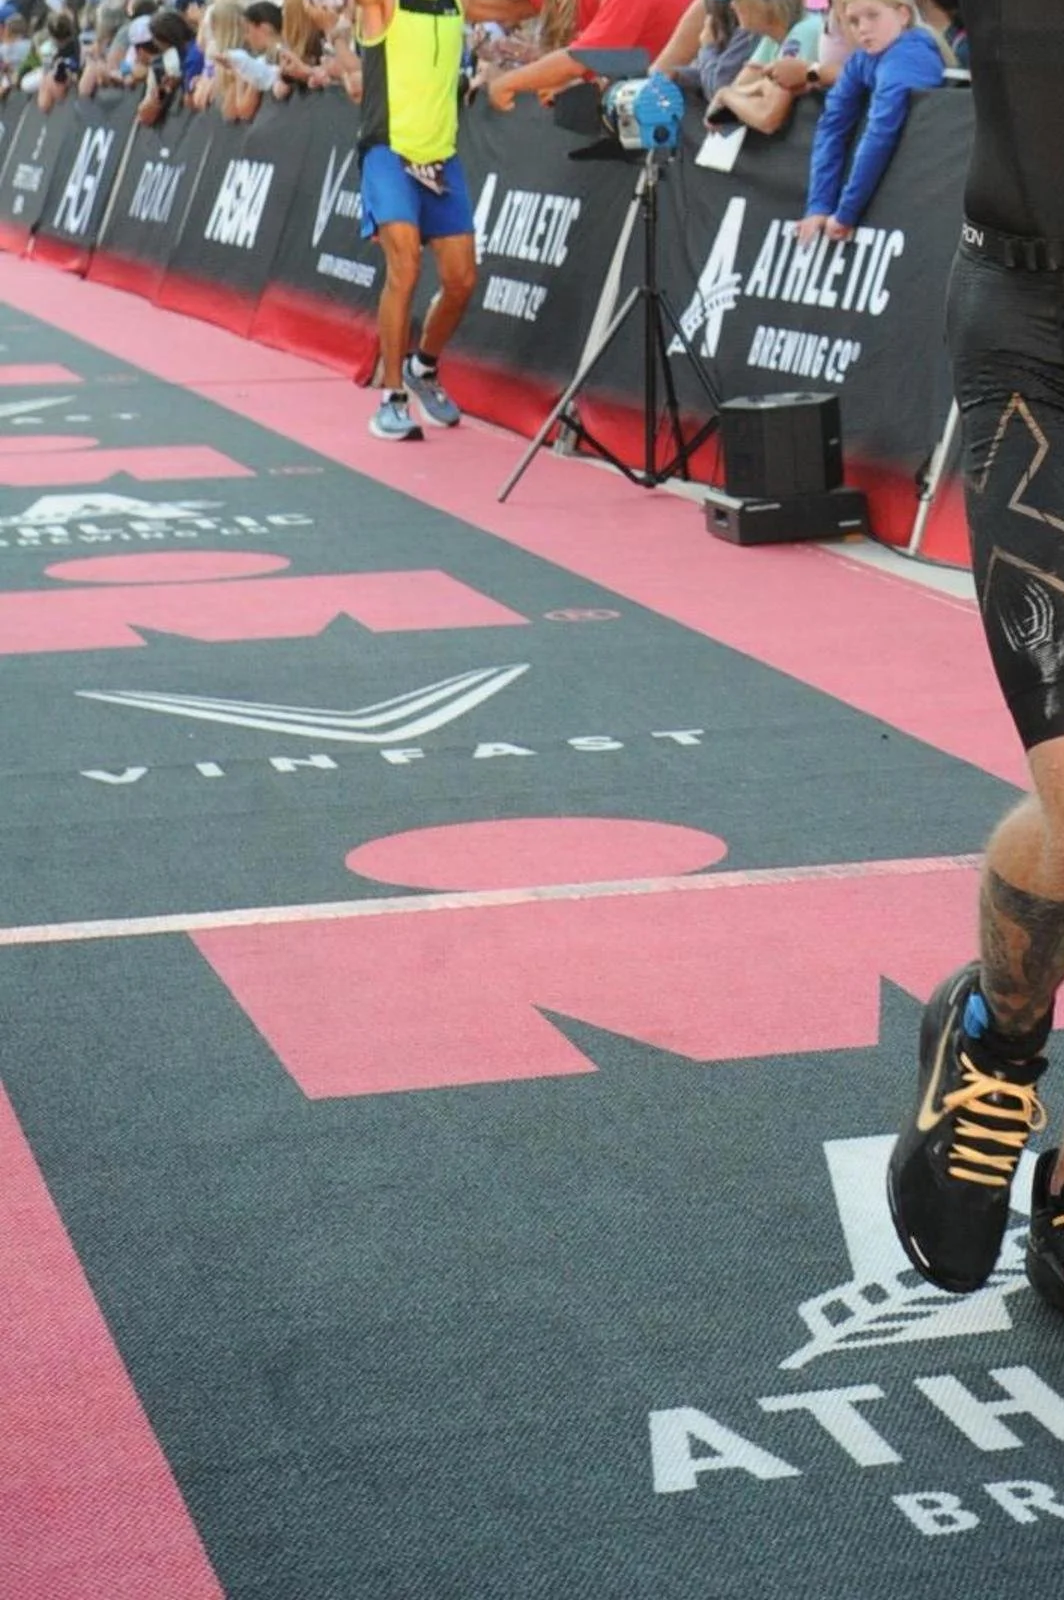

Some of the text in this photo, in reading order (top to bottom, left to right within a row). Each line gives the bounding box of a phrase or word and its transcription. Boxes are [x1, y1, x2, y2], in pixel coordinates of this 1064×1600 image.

[204, 159, 274, 249] HOKA
[487, 189, 581, 268] ATHLETIC
[744, 219, 905, 317] ATHLETIC
[747, 324, 830, 380] BREWING
[80, 728, 706, 786] VINFAST
